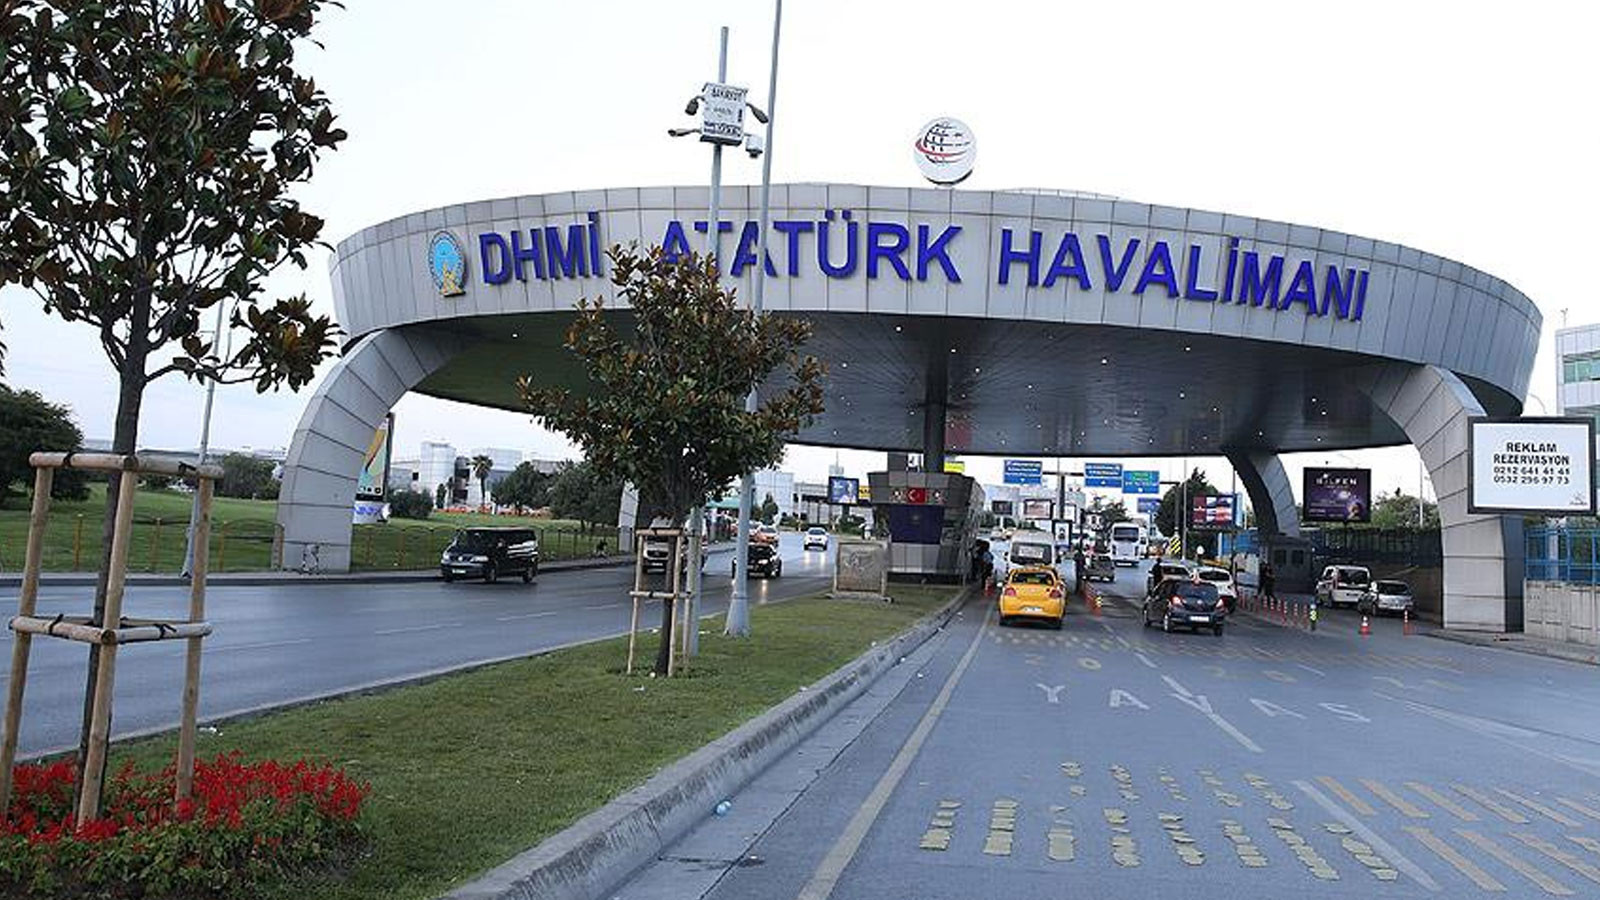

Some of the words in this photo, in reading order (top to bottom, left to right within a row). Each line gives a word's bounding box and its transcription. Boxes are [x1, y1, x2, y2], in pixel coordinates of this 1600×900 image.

[479, 211, 604, 286] DHMİ
[998, 227, 1370, 321] HAVALİMANI
[1506, 442, 1557, 453] REKLAM
[1493, 453, 1570, 466] REZERVASYON
[1493, 466, 1519, 475] 0212
